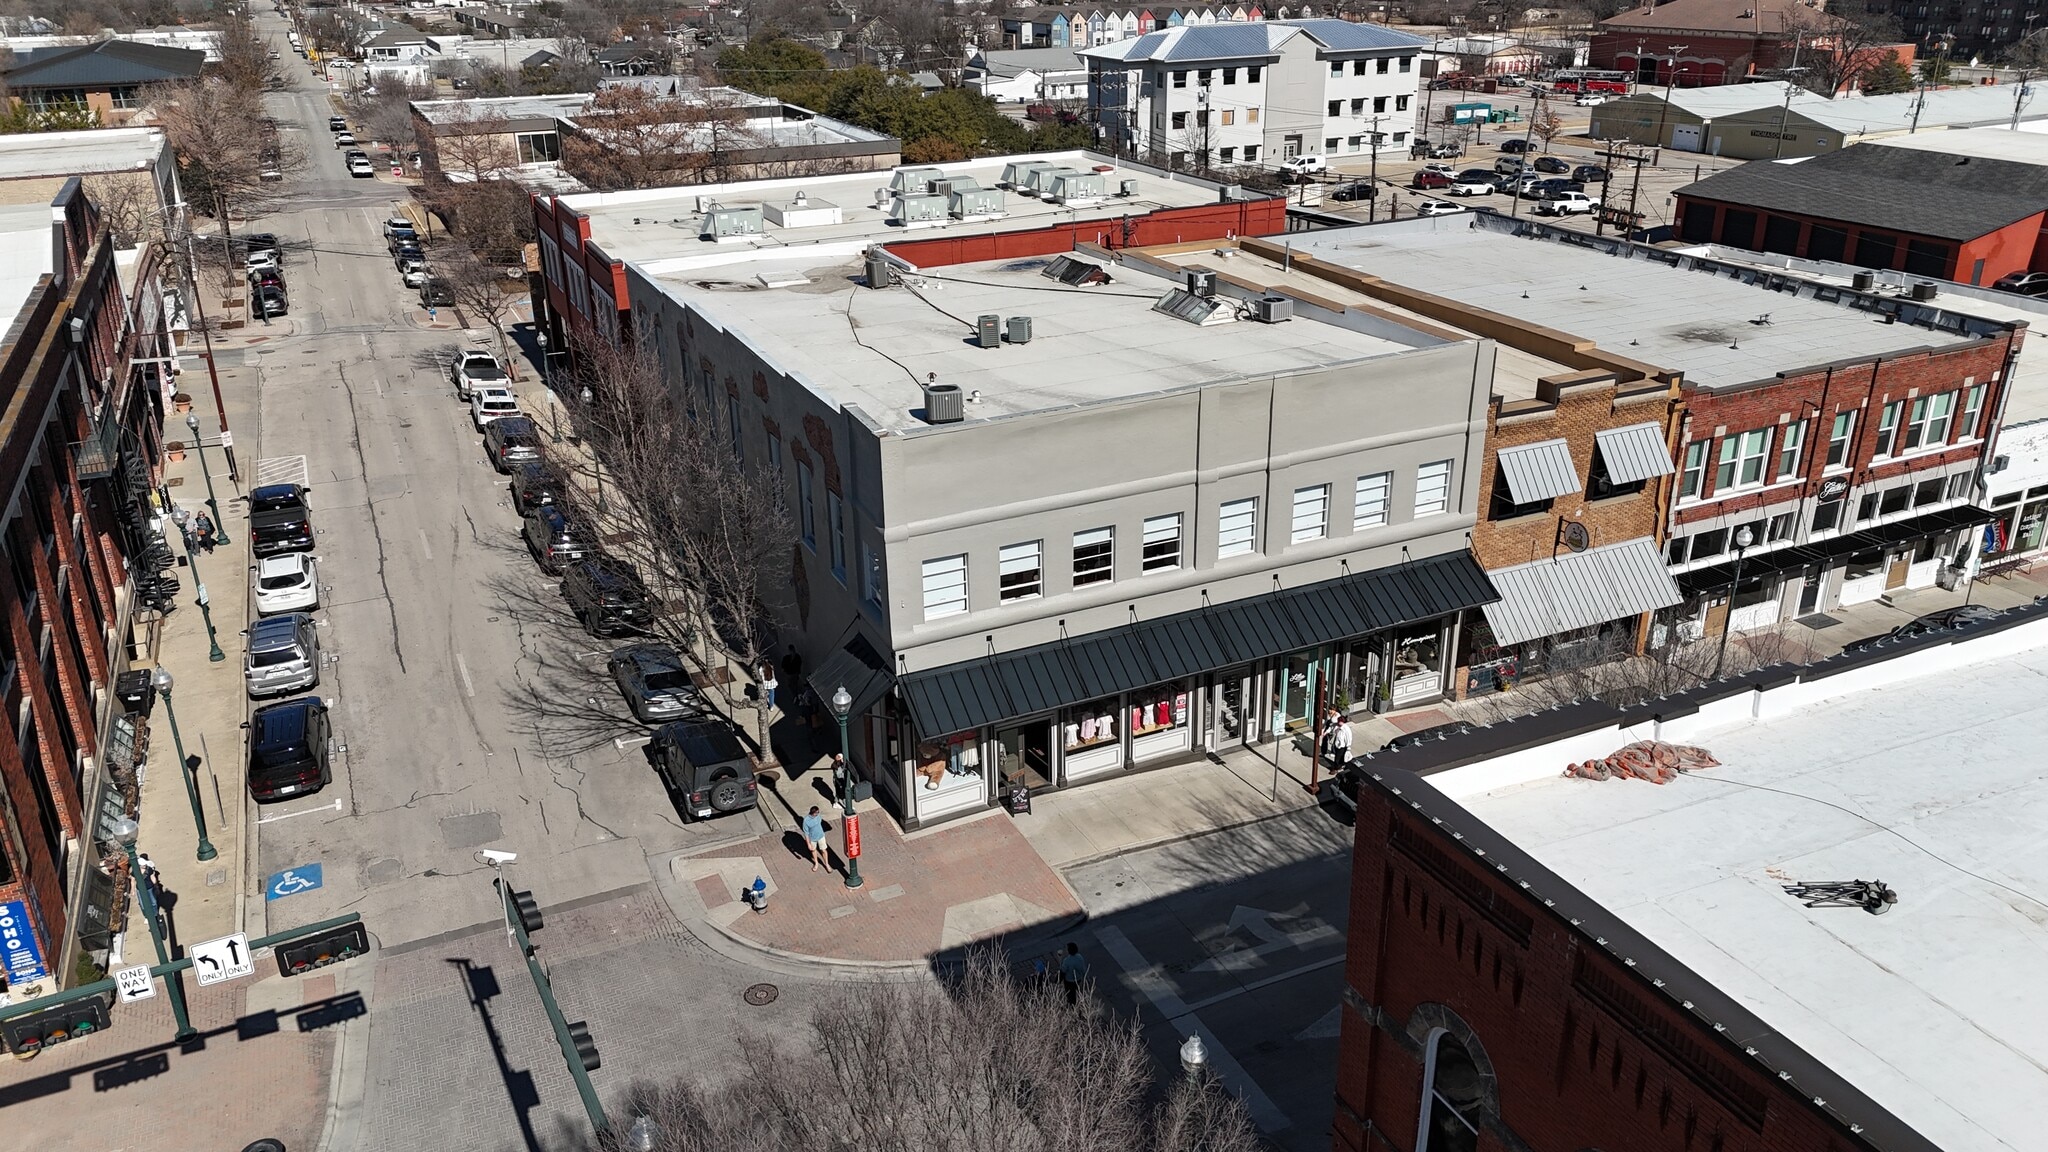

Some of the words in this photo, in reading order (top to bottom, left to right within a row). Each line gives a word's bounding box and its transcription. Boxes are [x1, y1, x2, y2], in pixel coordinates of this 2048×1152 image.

[120, 967, 146, 980] ONE
[228, 964, 249, 975] ONLY
[201, 970, 223, 982] ONLY
[121, 976, 147, 989] WAY
